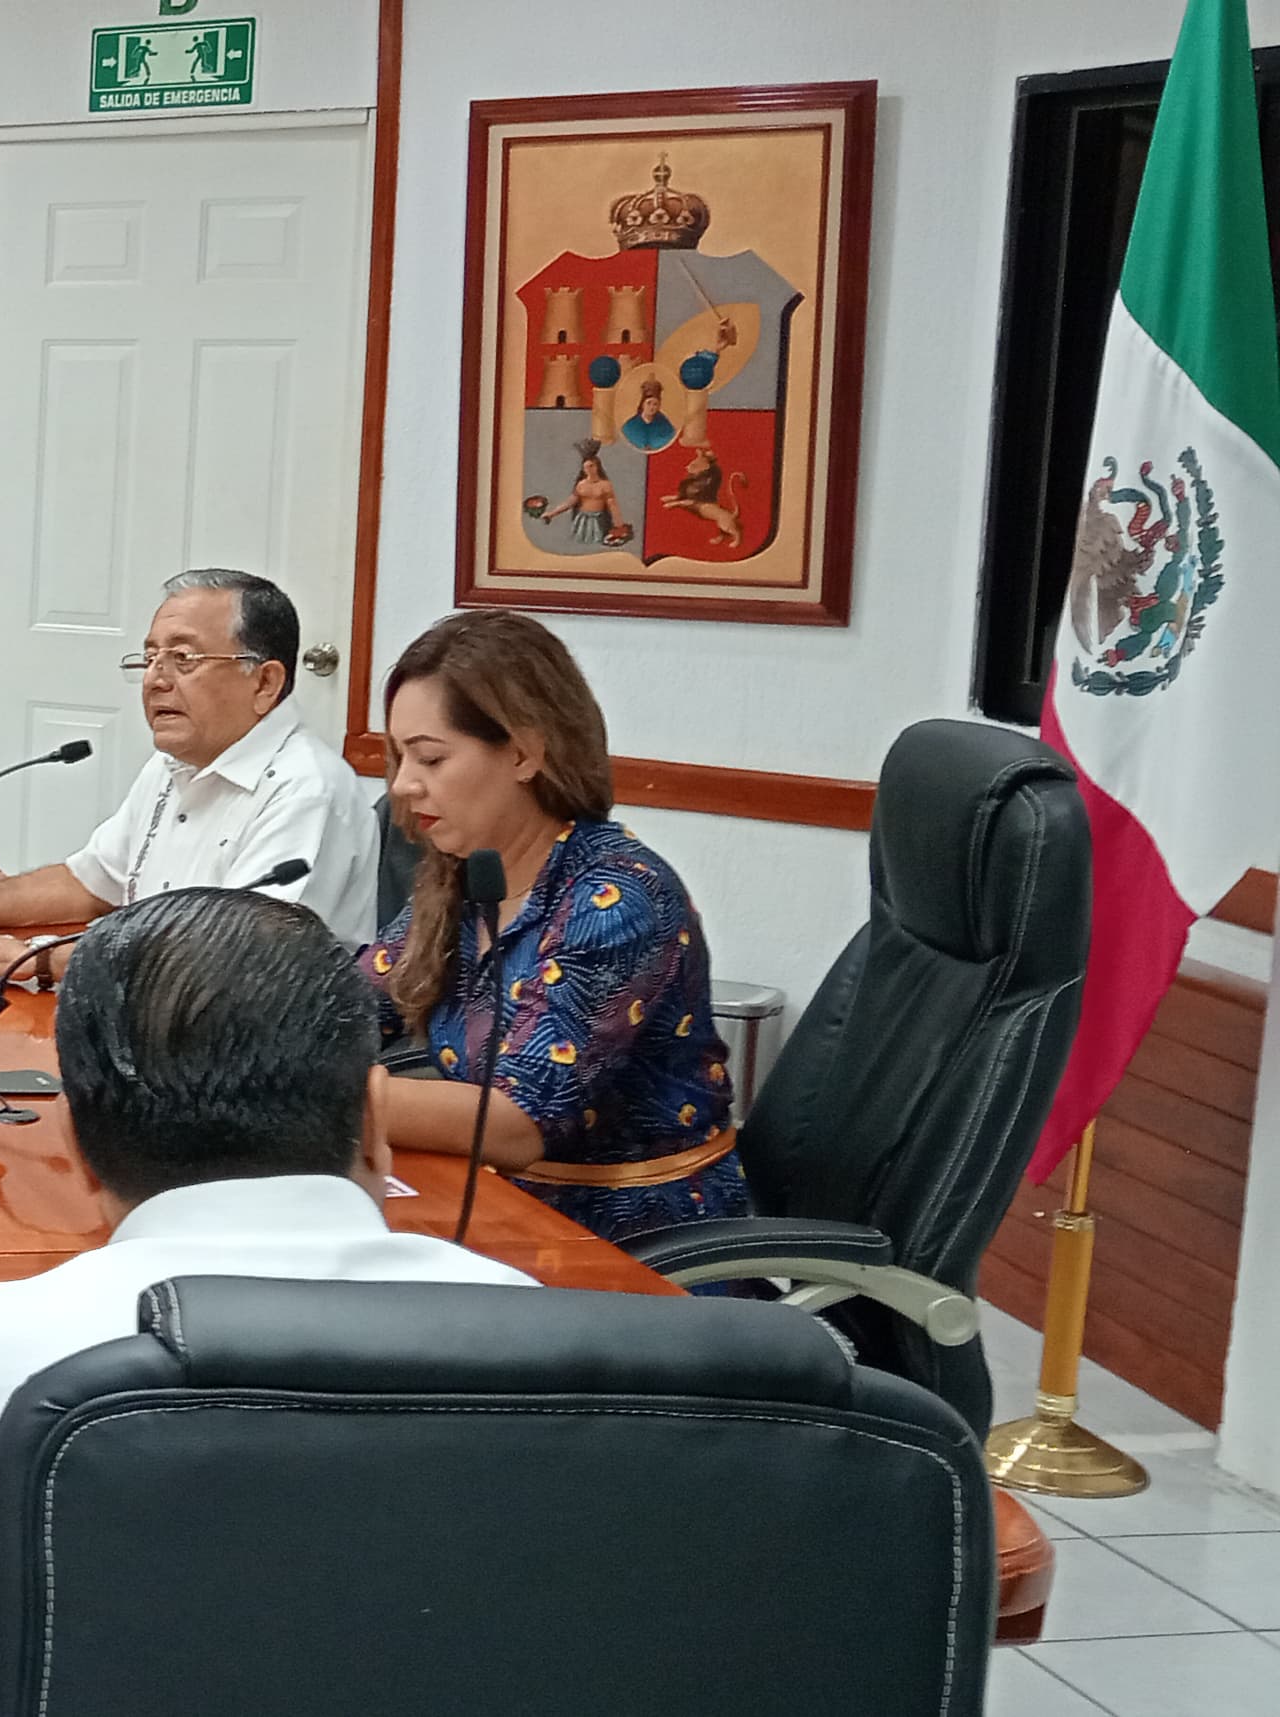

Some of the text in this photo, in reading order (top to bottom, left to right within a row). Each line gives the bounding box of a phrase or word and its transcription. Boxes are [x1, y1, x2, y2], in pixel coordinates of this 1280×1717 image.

[99, 87, 241, 109] SALIDA DE EMERGENCIA
